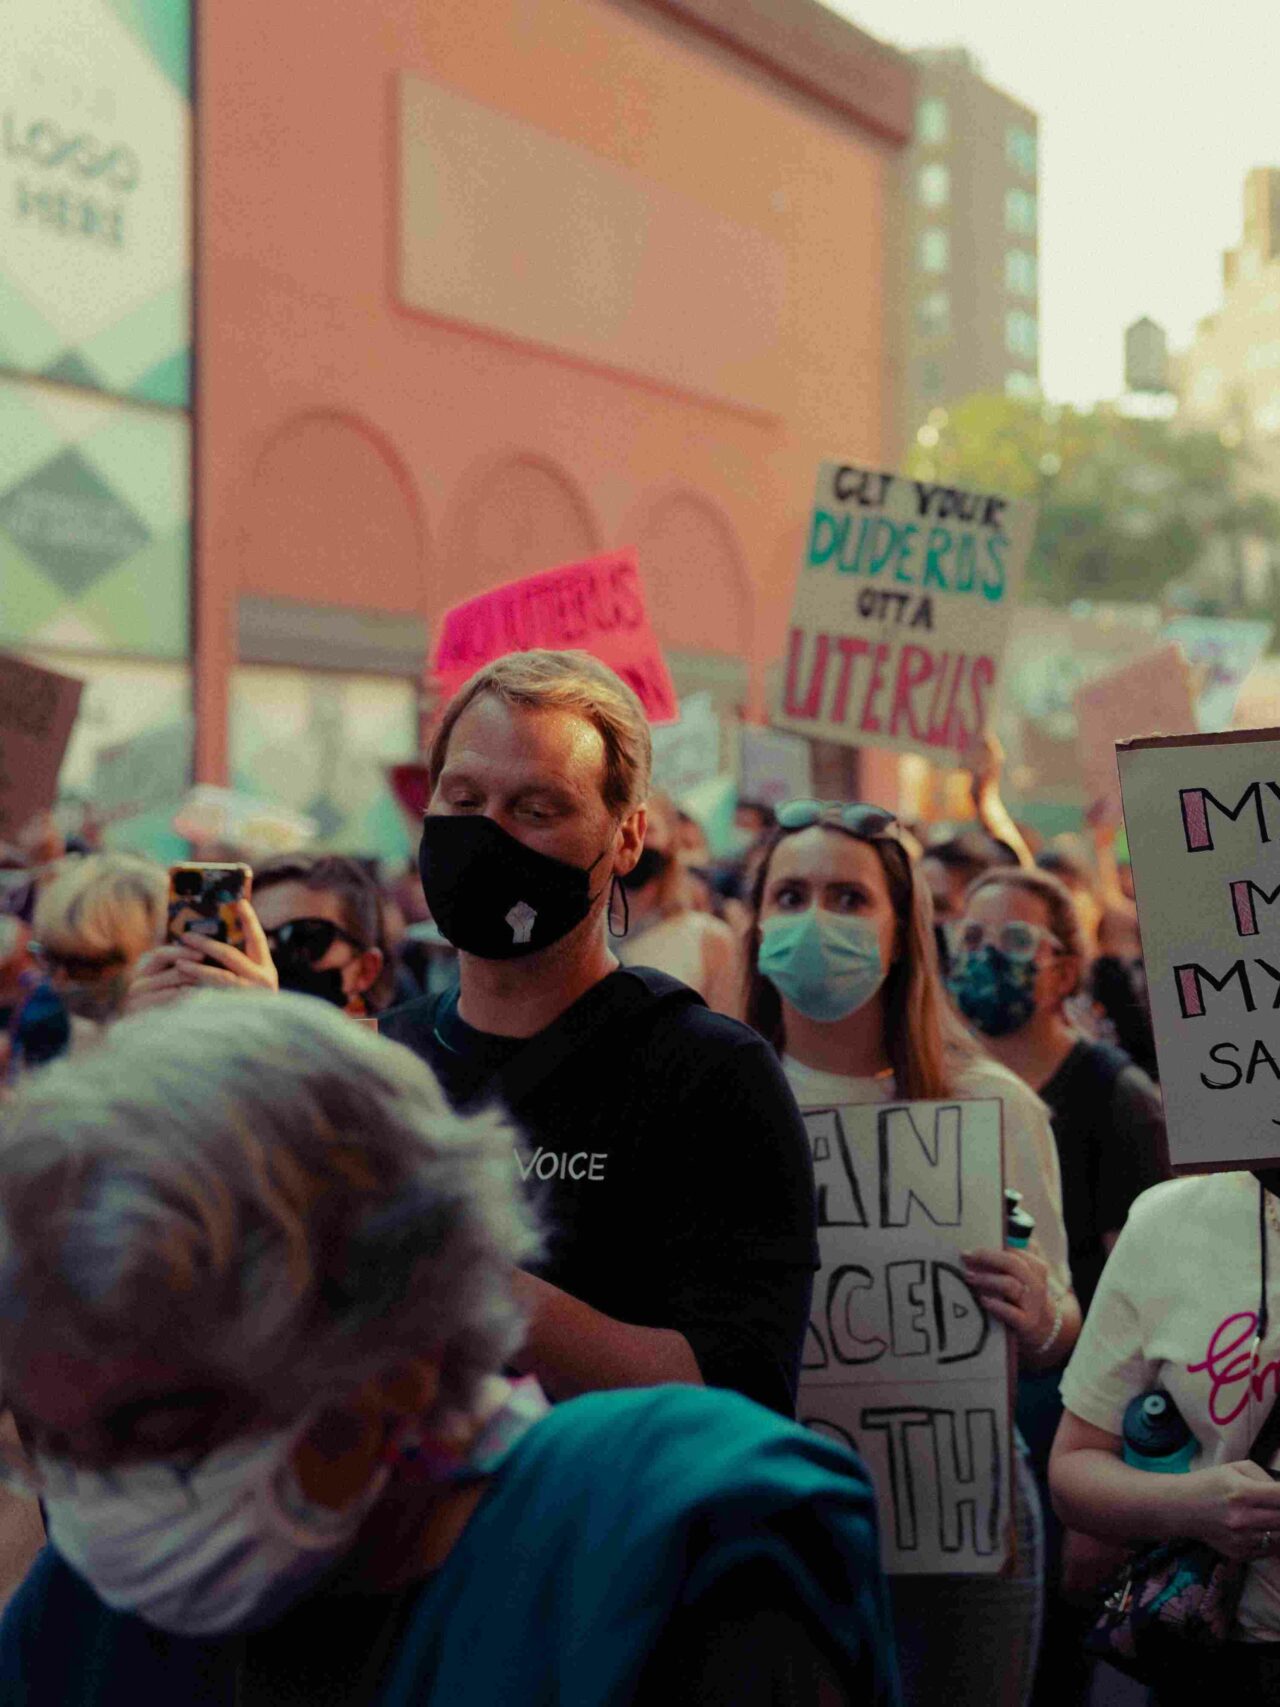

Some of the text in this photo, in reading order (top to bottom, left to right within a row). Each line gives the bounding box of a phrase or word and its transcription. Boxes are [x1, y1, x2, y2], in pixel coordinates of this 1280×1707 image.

[784, 627, 995, 751] UTERUS
[513, 1146, 608, 1182] VOICE
[800, 1260, 991, 1369] CED
[802, 1406, 999, 1556] TH
